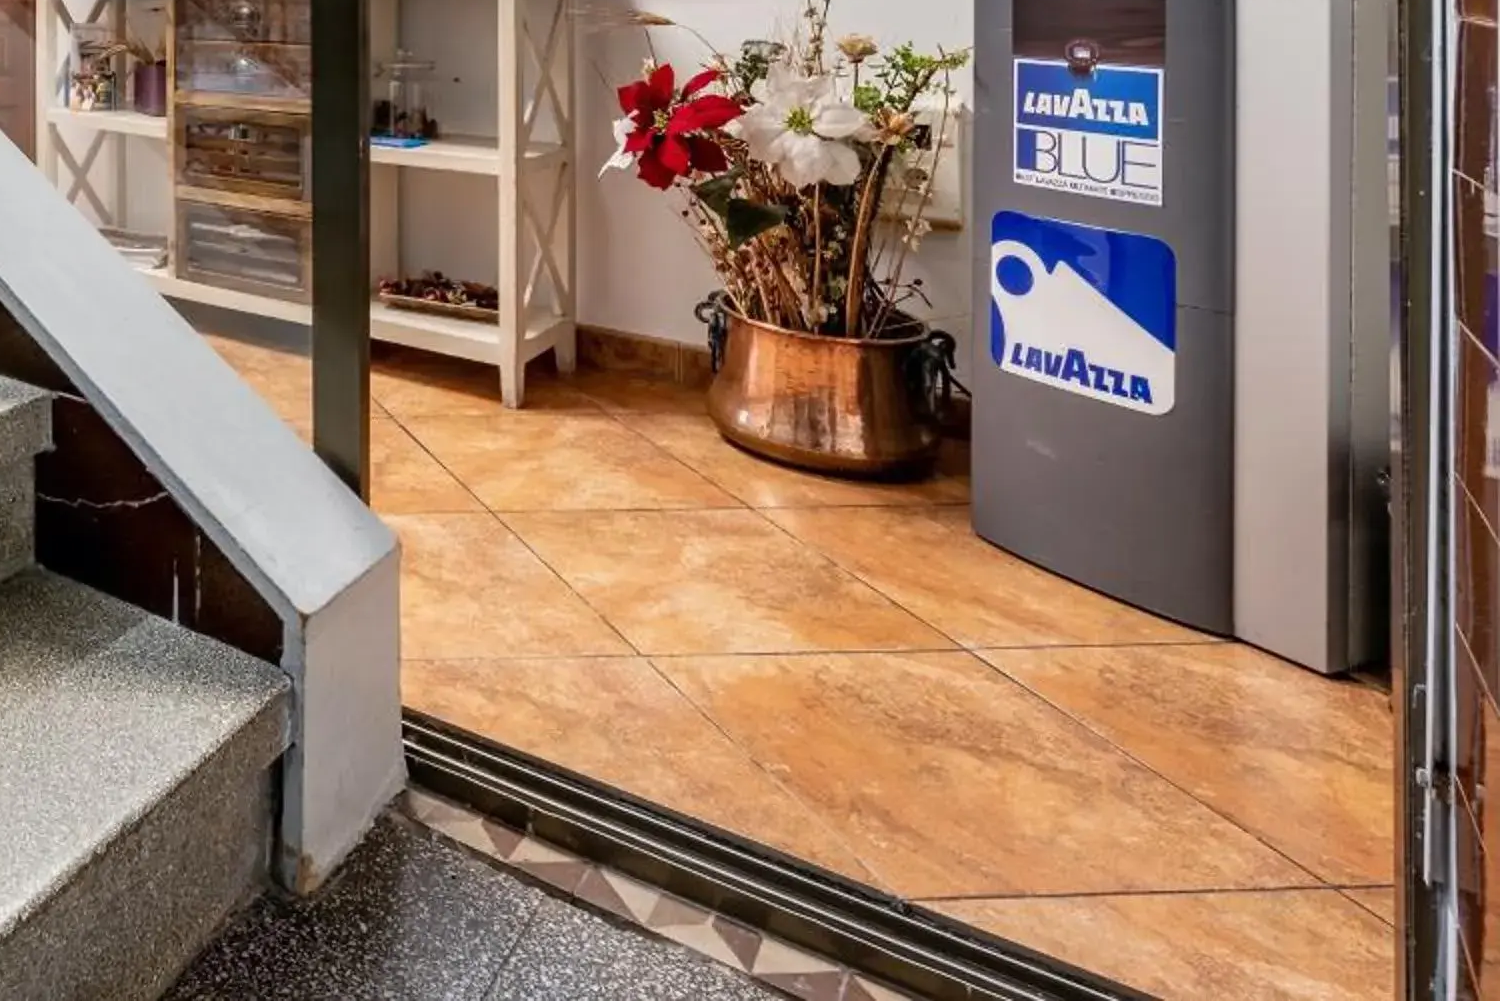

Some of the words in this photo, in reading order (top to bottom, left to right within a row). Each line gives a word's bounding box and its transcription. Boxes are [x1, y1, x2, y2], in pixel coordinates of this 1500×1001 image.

[1023, 88, 1149, 126] LAVAZZA
[1017, 129, 1159, 190] BLUE
[1010, 342, 1153, 404] LAVAZZA
